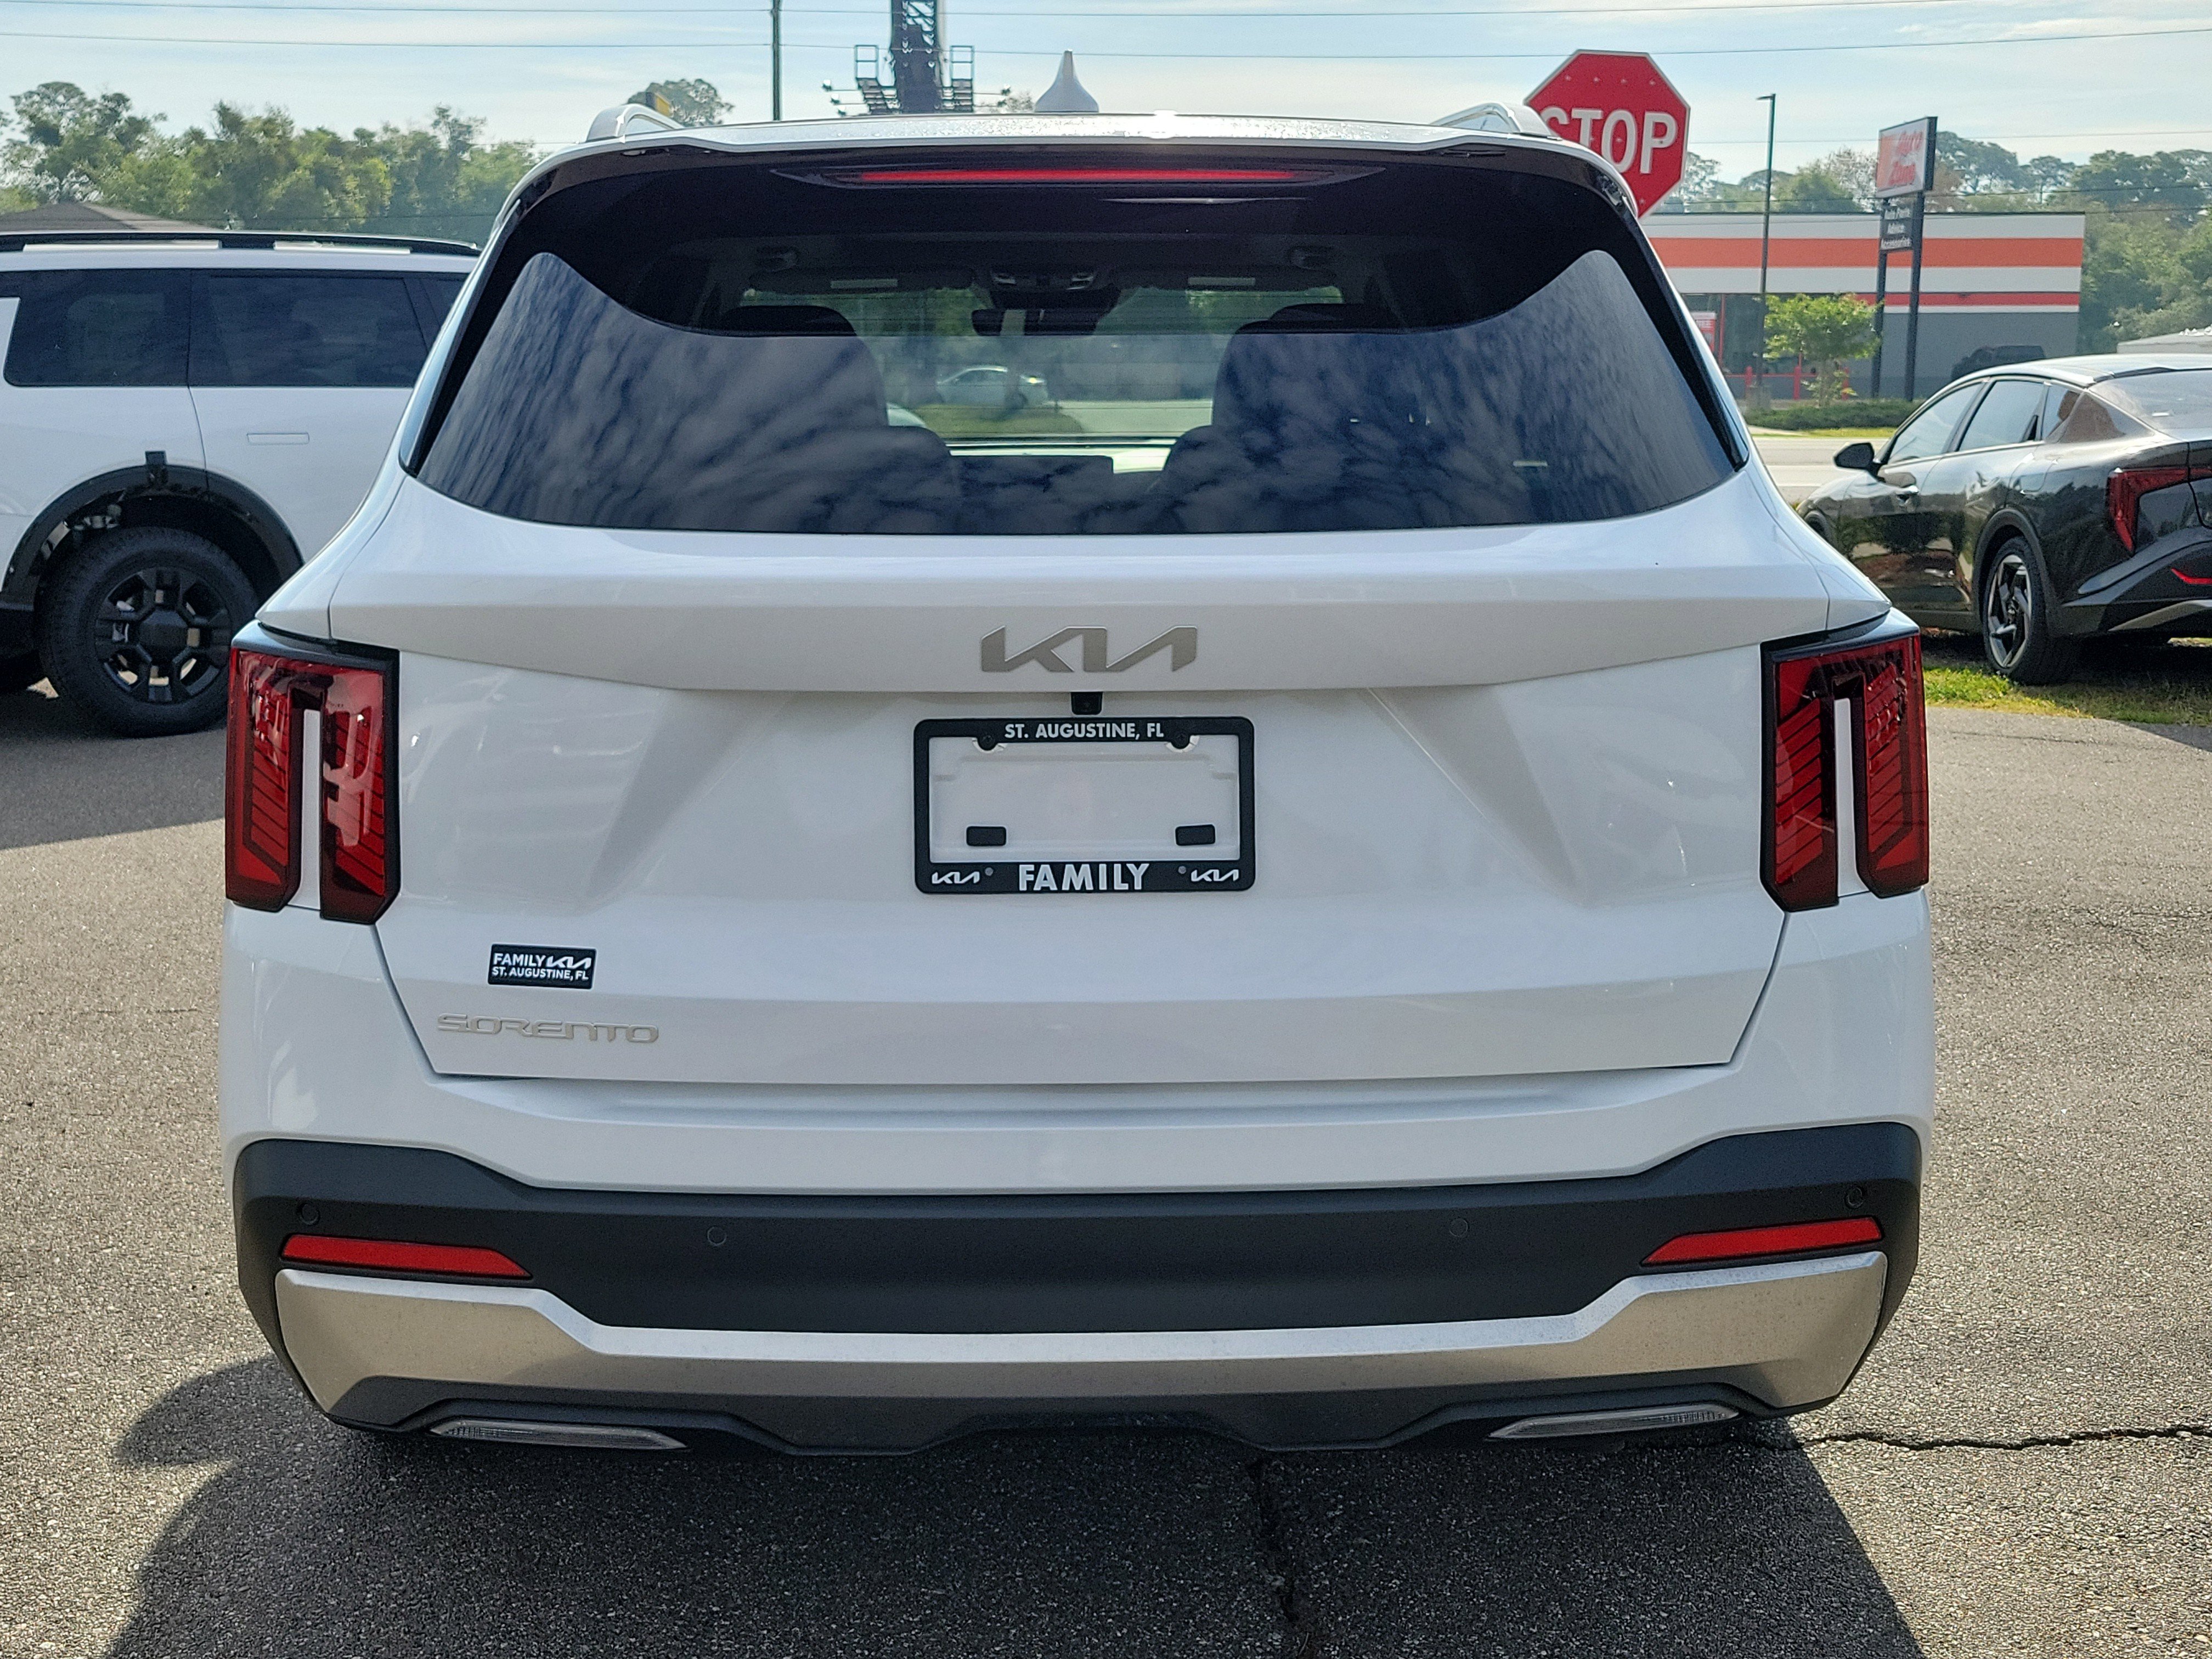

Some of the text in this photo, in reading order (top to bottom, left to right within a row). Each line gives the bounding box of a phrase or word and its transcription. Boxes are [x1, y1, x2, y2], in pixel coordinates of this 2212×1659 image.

[1005, 723, 1164, 740] ST. AUGUSTINE, FL
[1018, 863, 1150, 891] FAMILY
[493, 953, 546, 968] FAMILY
[492, 966, 589, 981] ST. AUGUSTINE, FL
[438, 1013, 658, 1043] SORENTO
